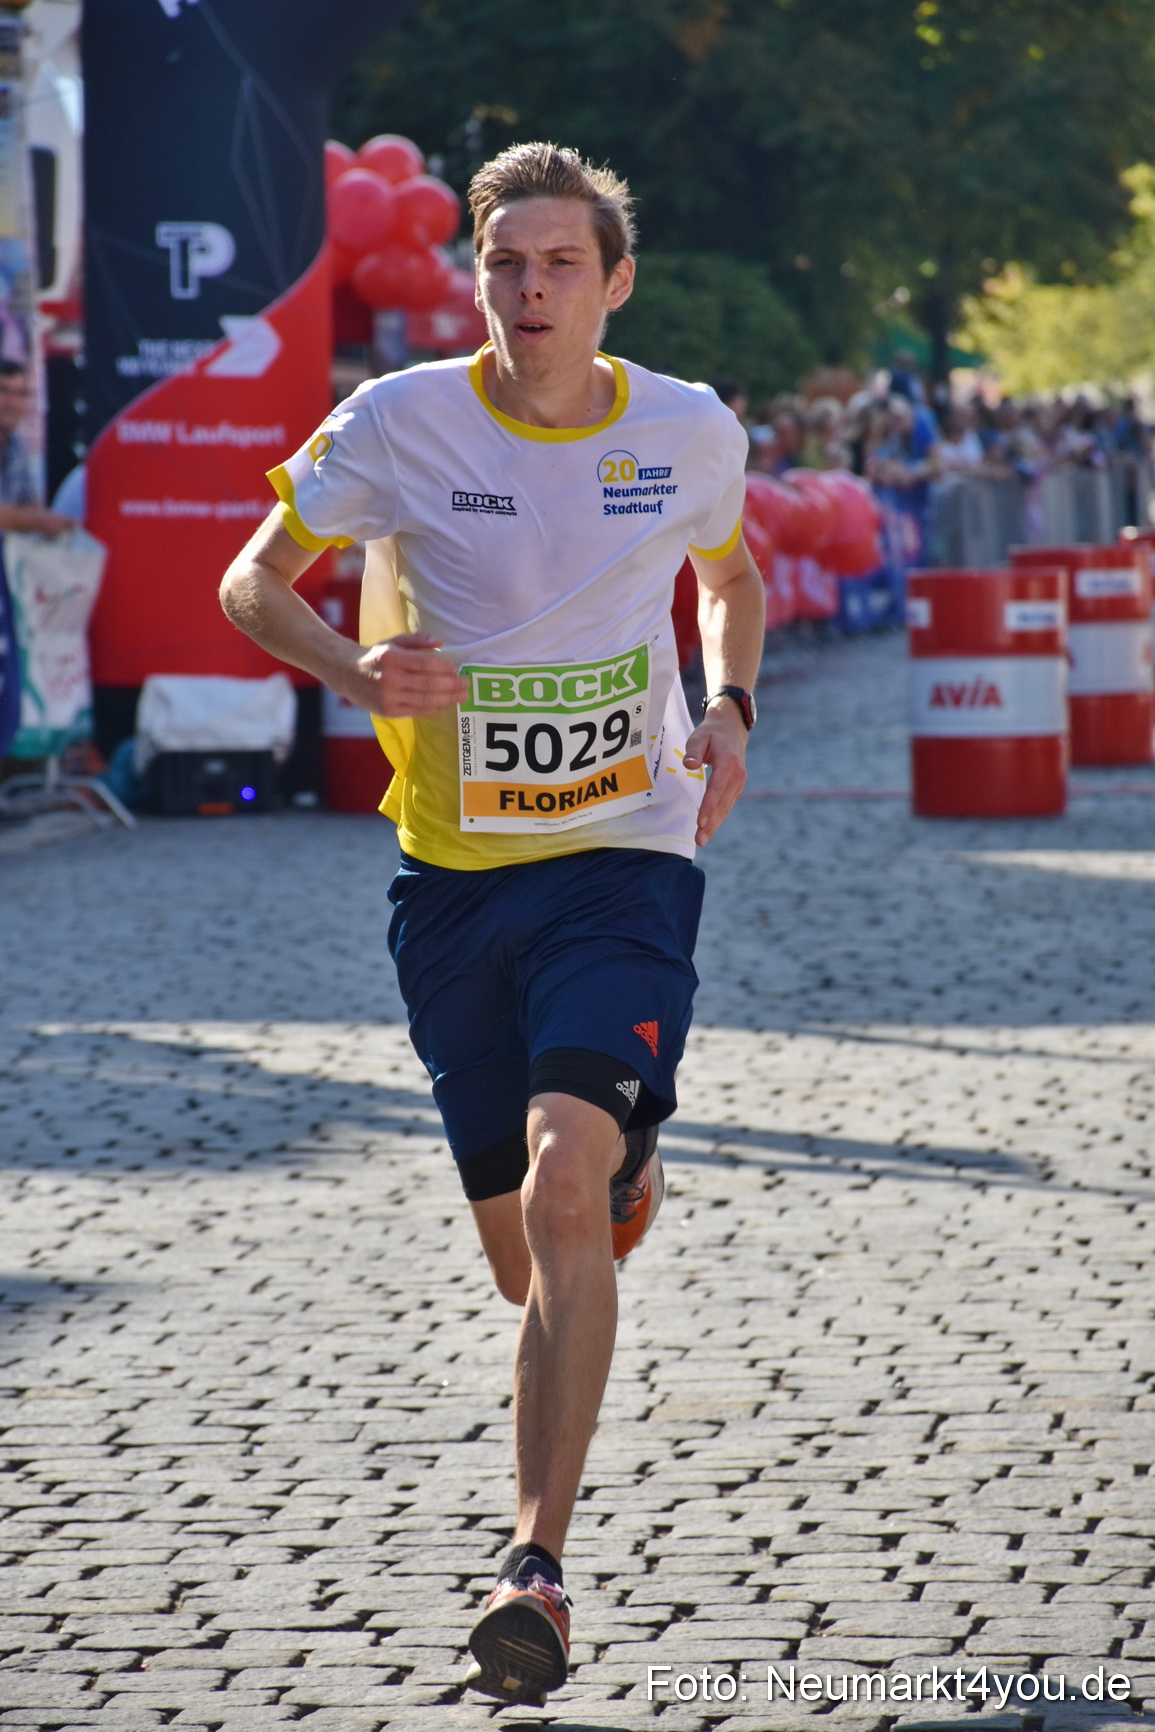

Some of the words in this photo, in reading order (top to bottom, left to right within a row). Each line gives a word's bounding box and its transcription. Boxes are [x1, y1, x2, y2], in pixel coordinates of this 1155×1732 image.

[117, 420, 172, 443] BMW
[175, 421, 286, 449] Laufsport
[602, 459, 636, 482] 20
[641, 468, 669, 479] JAHRE
[452, 491, 516, 511] BOCK
[603, 484, 678, 498] Neumarkter
[603, 500, 664, 515] Stadtlauf
[472, 655, 638, 708] BOCK
[930, 675, 1004, 709] AVIA
[636, 706, 642, 714] S
[485, 710, 630, 774] 5029
[500, 772, 619, 812] FLORIAN
[615, 1082, 636, 1109] adidas
